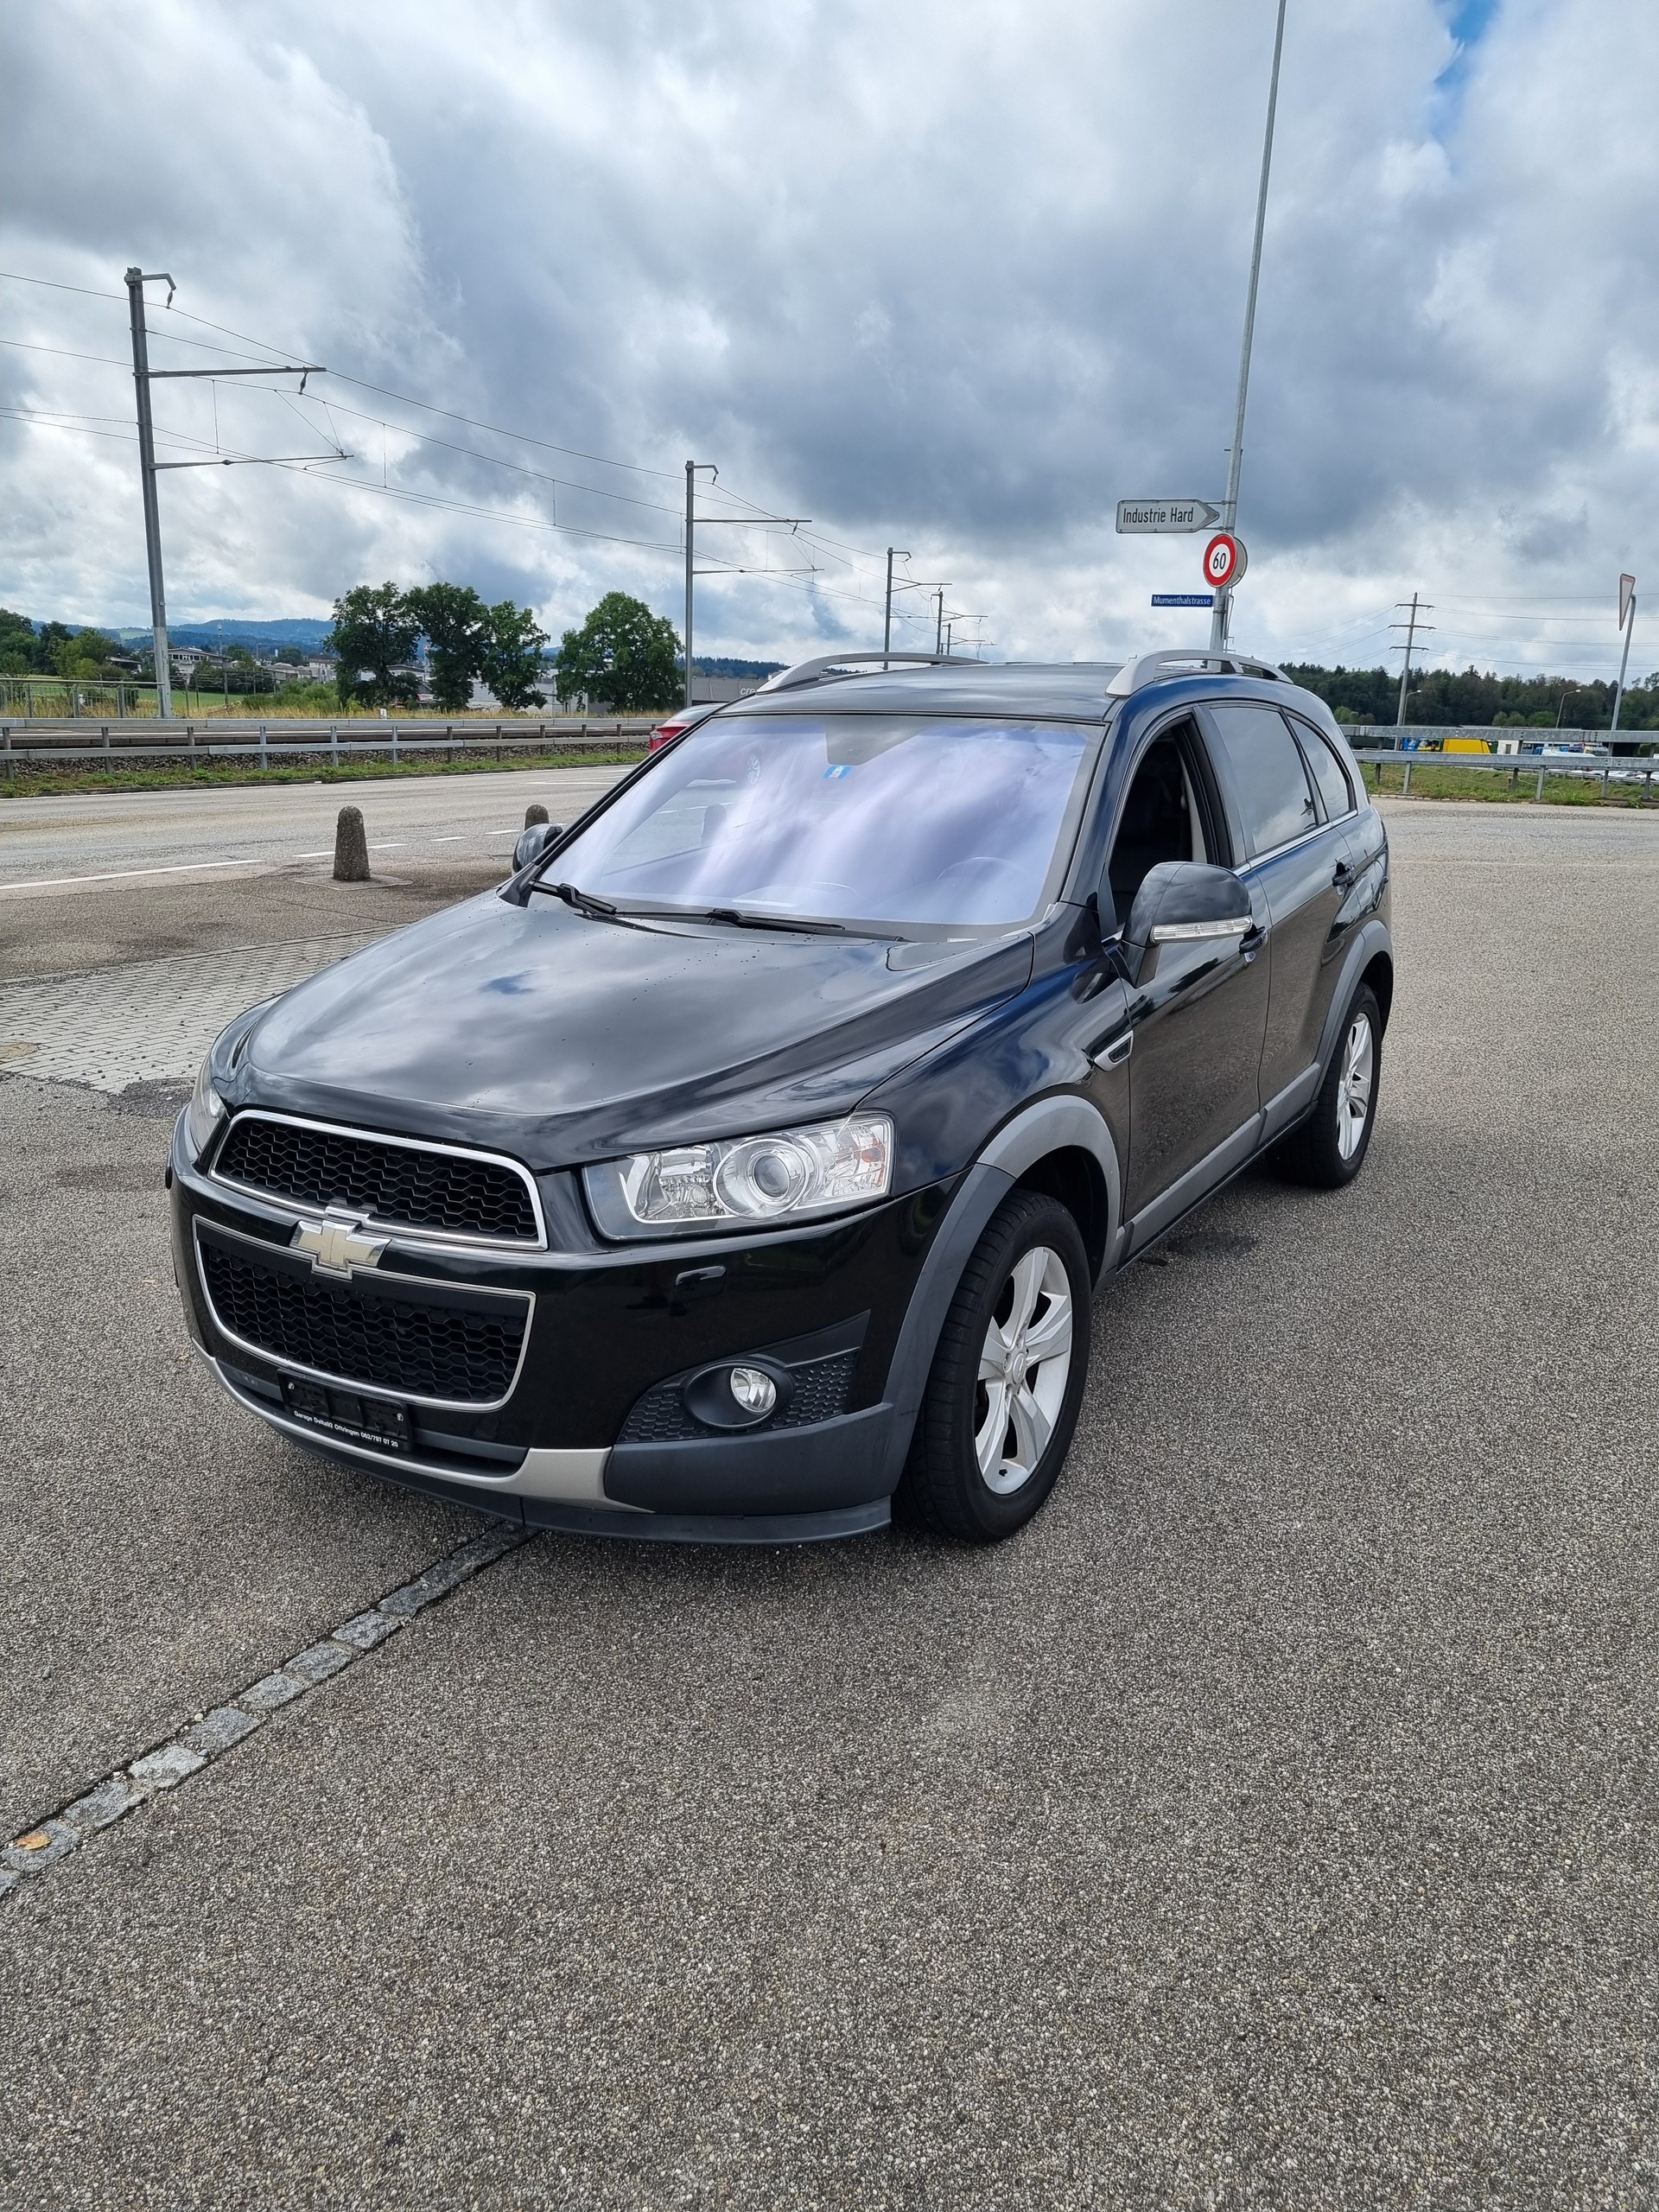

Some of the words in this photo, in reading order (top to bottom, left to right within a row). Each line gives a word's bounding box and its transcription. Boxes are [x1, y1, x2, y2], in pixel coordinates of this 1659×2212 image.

[1123, 508, 1166, 523] Industrie
[1170, 507, 1194, 522] Hard
[1212, 552, 1226, 569] 60
[1153, 596, 1211, 605] Mumenthalstrasse
[294, 1410, 313, 1421] Garage
